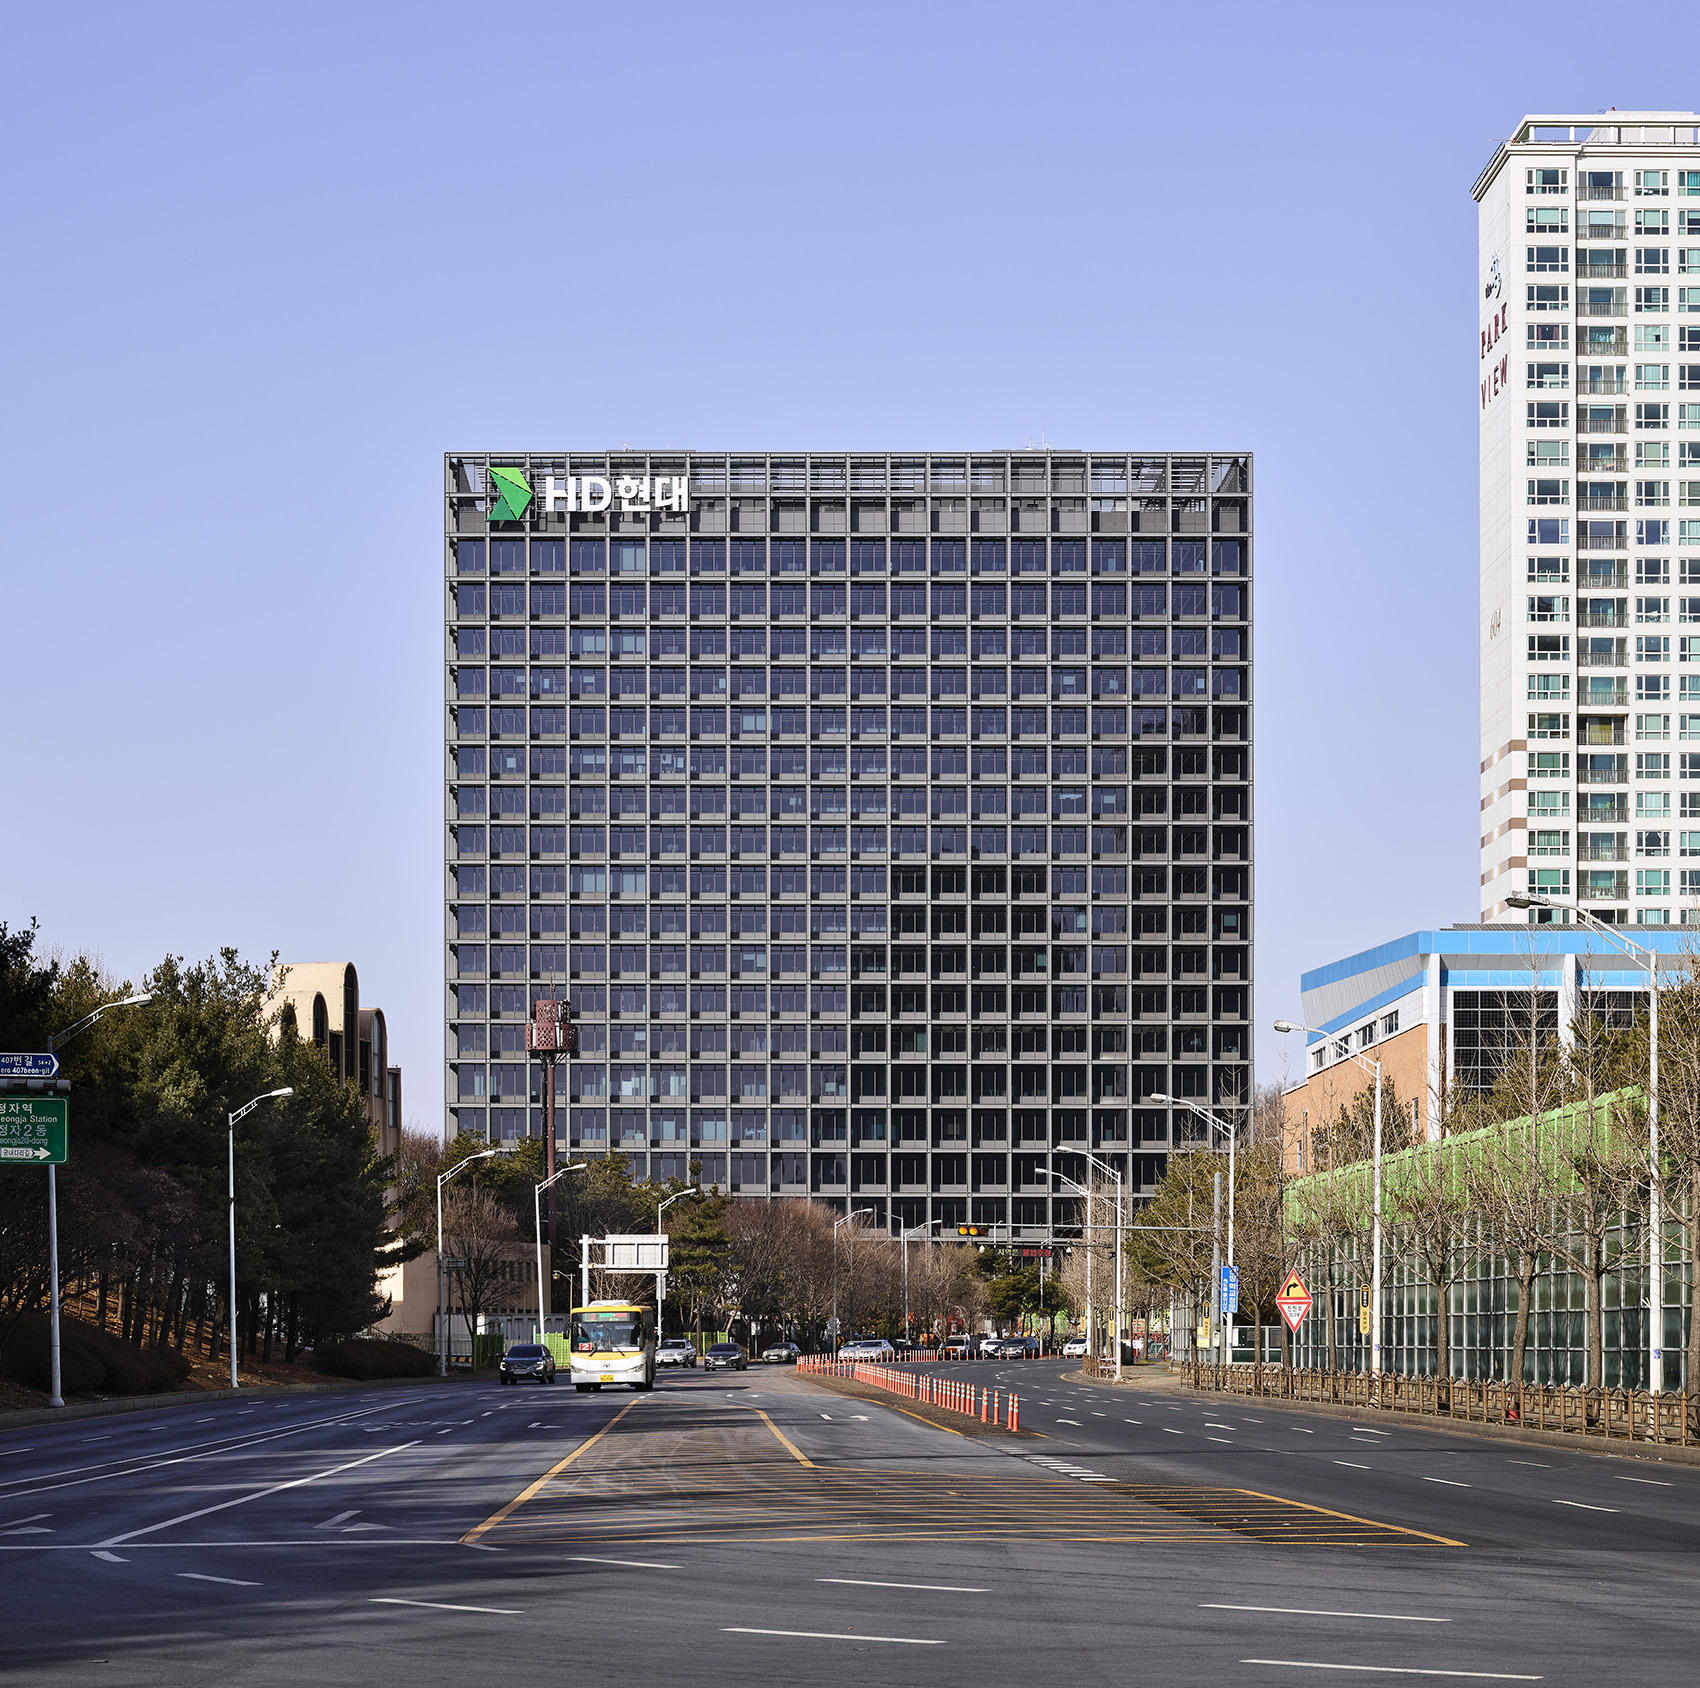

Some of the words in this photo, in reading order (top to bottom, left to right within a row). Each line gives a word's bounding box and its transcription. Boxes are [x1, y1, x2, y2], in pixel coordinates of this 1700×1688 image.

[1481, 302, 1508, 359] PARK
[1481, 354, 1508, 409] VIEW
[29, 1114, 58, 1123] Station
[590, 1313, 596, 1321] 2
[581, 1343, 590, 1351] 2
